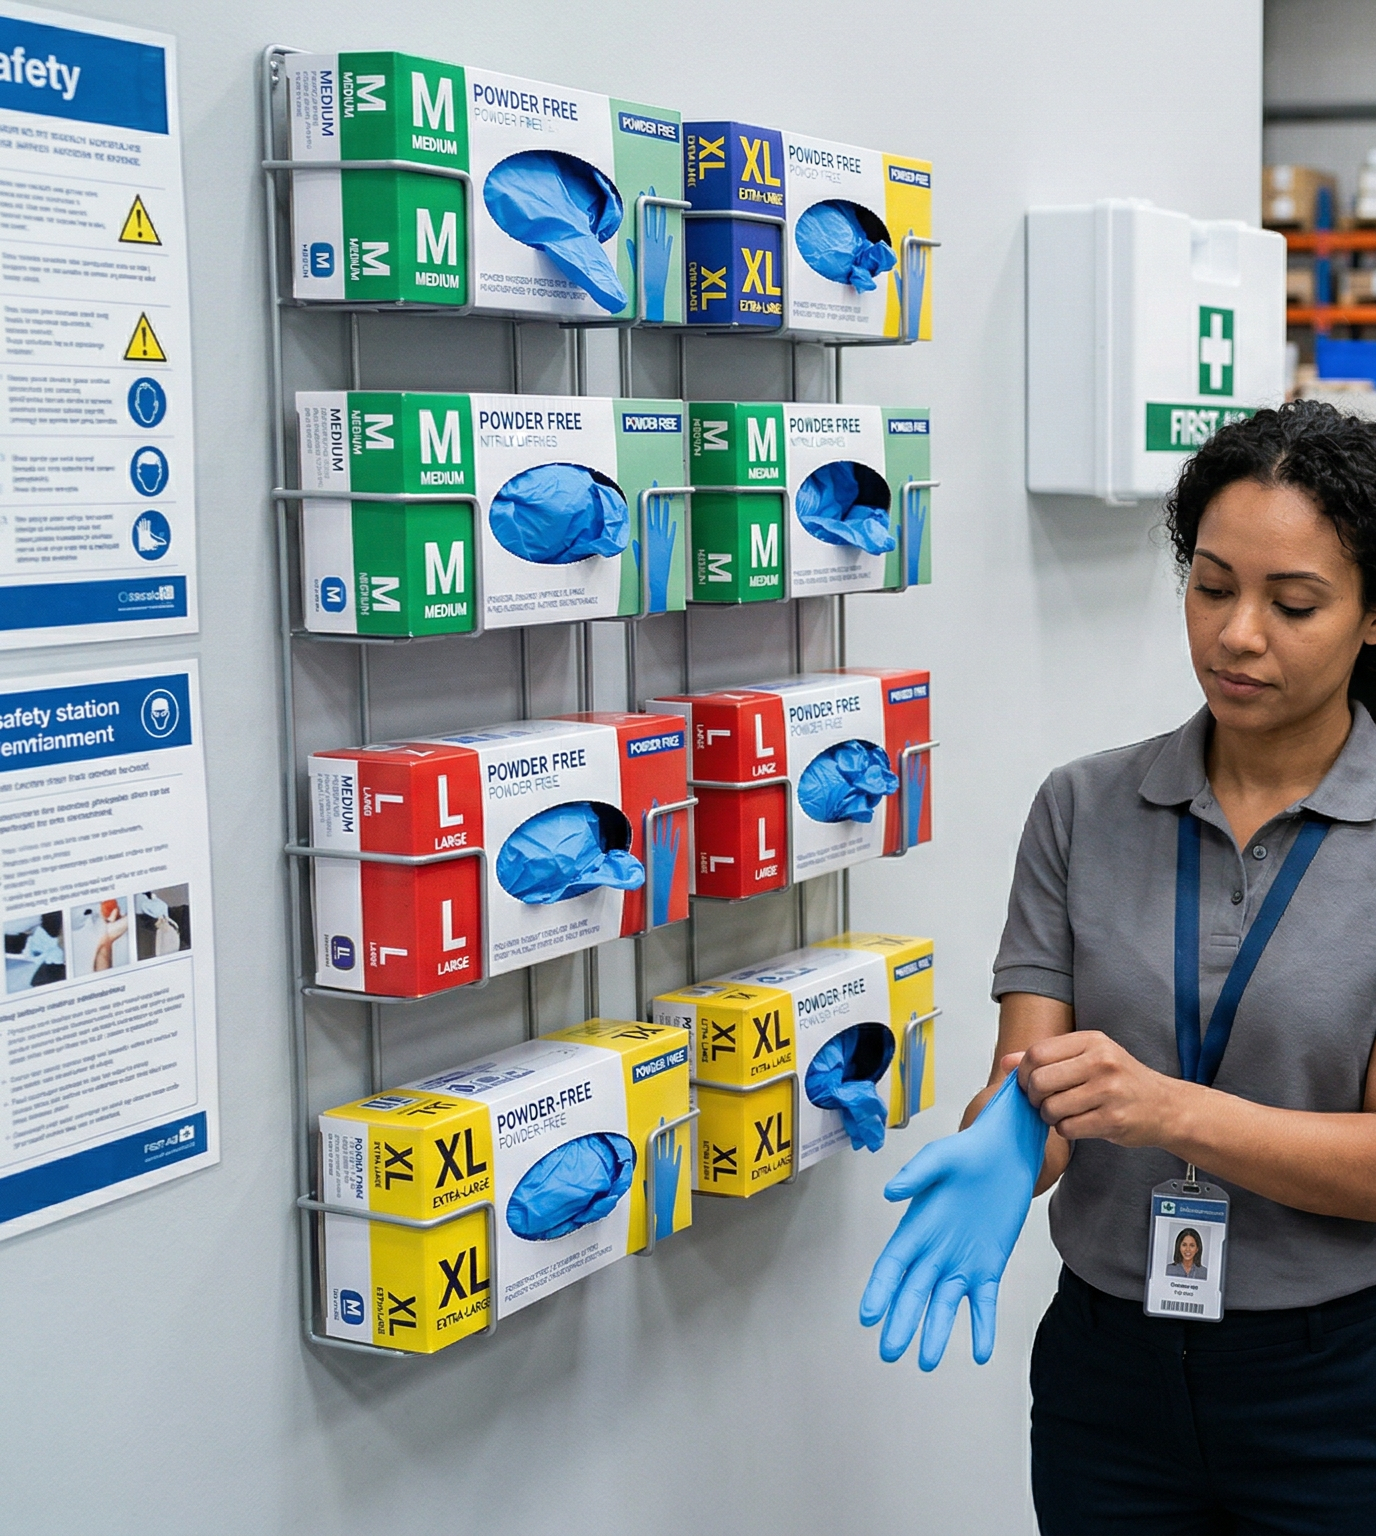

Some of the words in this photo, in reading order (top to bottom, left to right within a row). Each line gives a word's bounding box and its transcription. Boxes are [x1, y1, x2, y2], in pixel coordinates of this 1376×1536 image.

[319, 70, 334, 137] MEDIUM
[356, 74, 387, 112] M
[411, 71, 455, 133] M
[473, 83, 540, 114] POWDER
[543, 97, 578, 122] FREE
[411, 134, 458, 155] MEDIUM
[698, 136, 726, 180] XL
[739, 136, 781, 188] XL
[789, 145, 834, 168] POWDER
[836, 154, 862, 174] FREE
[416, 208, 457, 266] M
[315, 252, 330, 269] M
[362, 241, 391, 277] M
[415, 271, 459, 289] MEDIUM
[740, 247, 782, 296] XL
[701, 266, 727, 311] XL
[330, 408, 344, 472] MEDIUM
[364, 413, 395, 450] M
[418, 409, 462, 465] M
[479, 411, 544, 430] POWDER
[548, 412, 582, 430] FREE
[703, 420, 729, 450] M
[747, 417, 777, 462] M
[789, 417, 834, 433] POWDER
[836, 418, 861, 433] FREE
[420, 470, 465, 486] MEDIUM
[708, 552, 732, 582] M
[751, 523, 778, 569] M
[424, 540, 465, 596] M
[326, 586, 341, 603] M
[370, 575, 400, 613] M
[424, 602, 467, 619] MEDIUM
[56, 699, 120, 722] station
[789, 701, 834, 723] POWDER
[836, 695, 861, 714] FREE
[754, 713, 775, 759] L
[488, 755, 549, 783] POWDER
[552, 748, 587, 770] FREE
[340, 774, 354, 834] MEDIUM
[374, 792, 404, 814] L
[437, 774, 464, 828] L
[758, 817, 776, 861] L
[441, 899, 467, 953] L
[379, 946, 408, 966] L
[711, 1020, 736, 1062] XL
[752, 1009, 791, 1060] XL
[497, 1081, 593, 1134] POWDER-FREE
[435, 1127, 488, 1189] XL
[753, 1111, 791, 1164] XL
[384, 1141, 415, 1191] XL
[712, 1144, 737, 1183] XL
[438, 1245, 491, 1310] XL
[345, 1300, 361, 1318] M
[386, 1291, 417, 1337] XL
